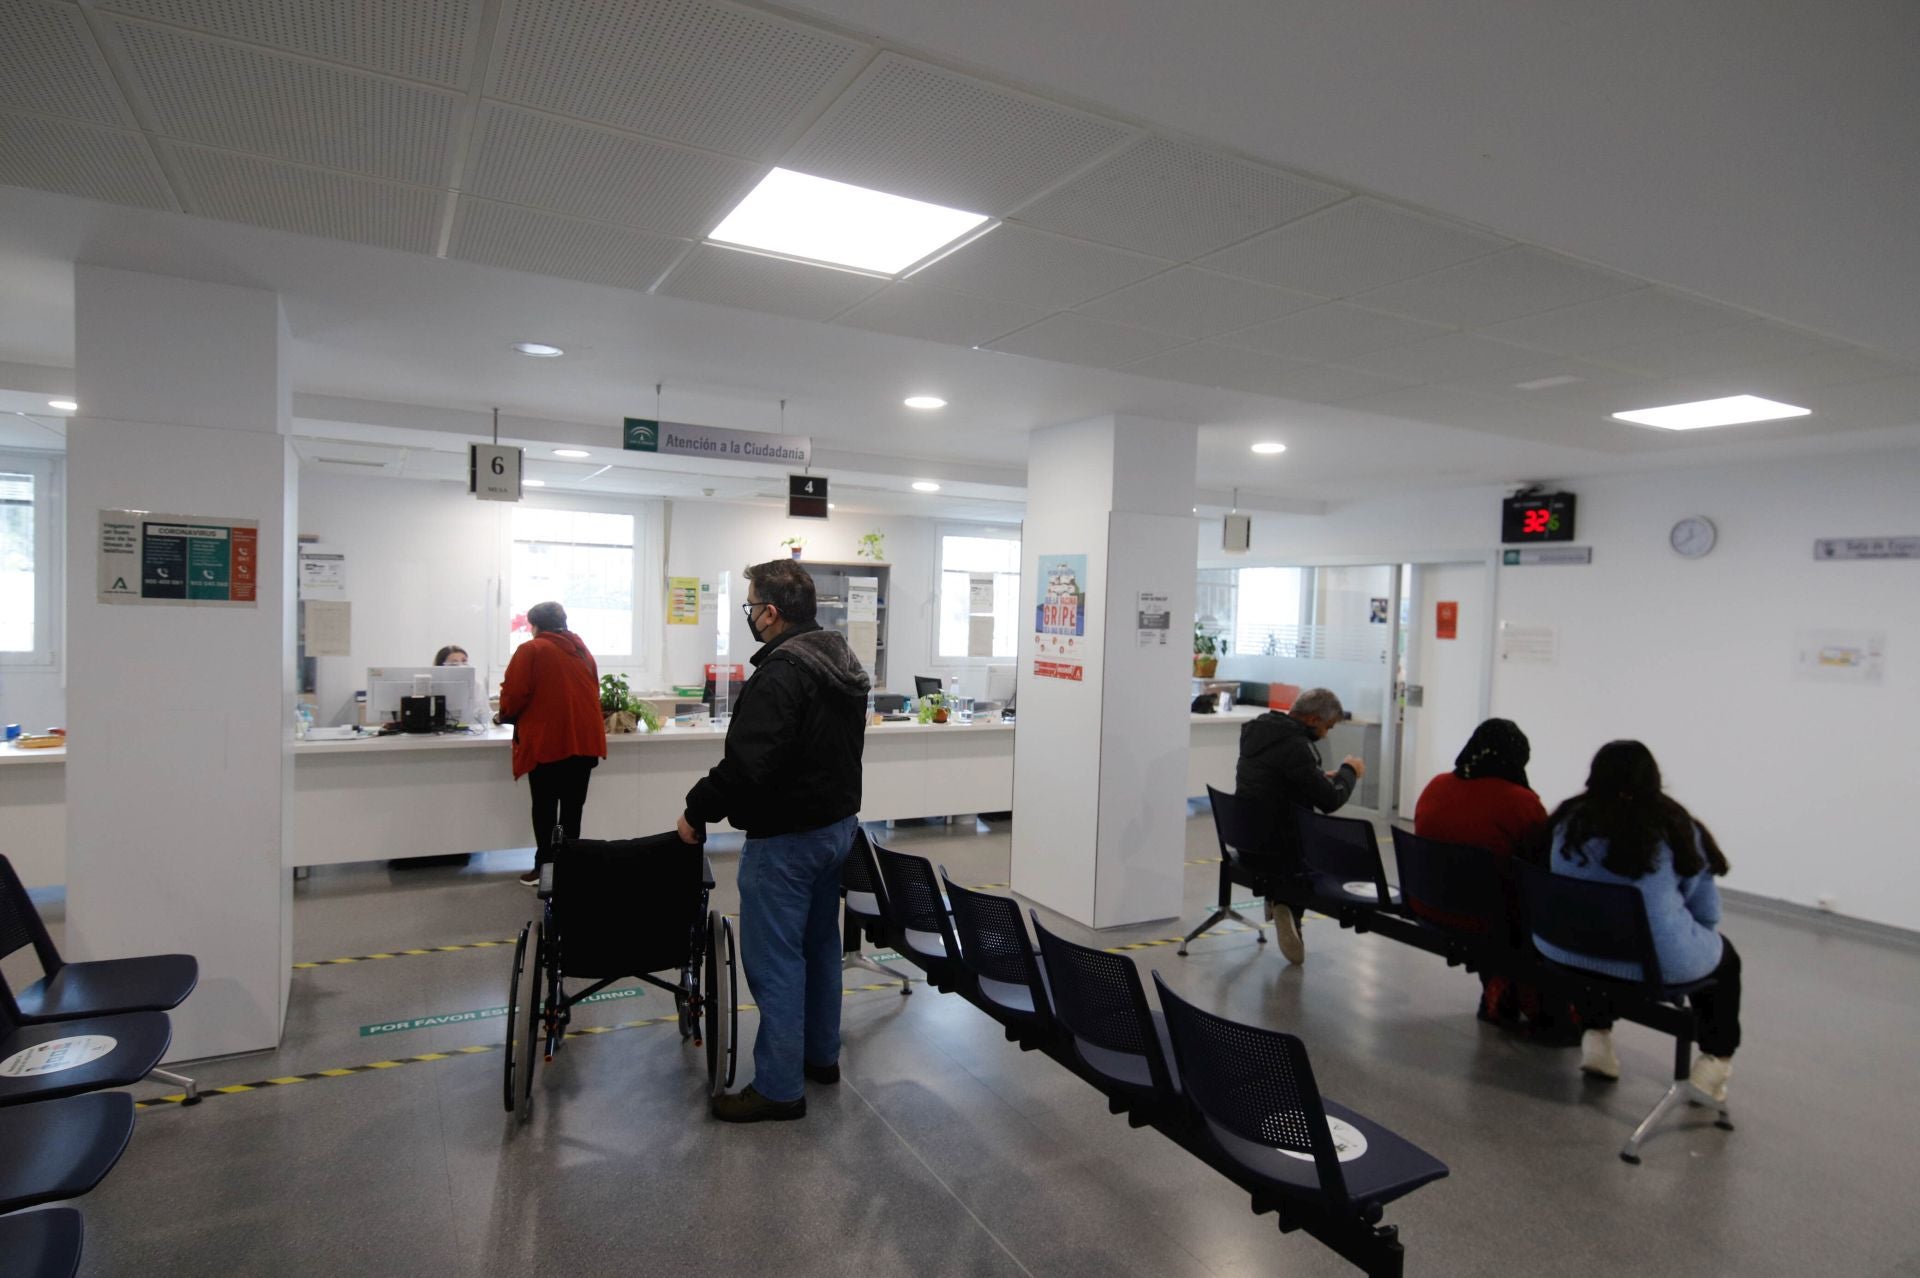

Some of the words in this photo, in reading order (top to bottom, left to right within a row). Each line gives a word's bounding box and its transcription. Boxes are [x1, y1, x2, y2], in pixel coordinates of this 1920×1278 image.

[665, 434, 717, 451] Atención
[720, 442, 727, 453] a
[730, 440, 740, 454] la
[743, 442, 805, 461] Ciudadanía
[491, 456, 505, 475] 6
[804, 481, 814, 493] 4
[1523, 509, 1550, 533] 32
[158, 527, 217, 538] CORONAVIRUS
[1044, 605, 1076, 627] GRIPE
[370, 1022, 409, 1034] POR
[413, 1012, 476, 1027] FAVOR
